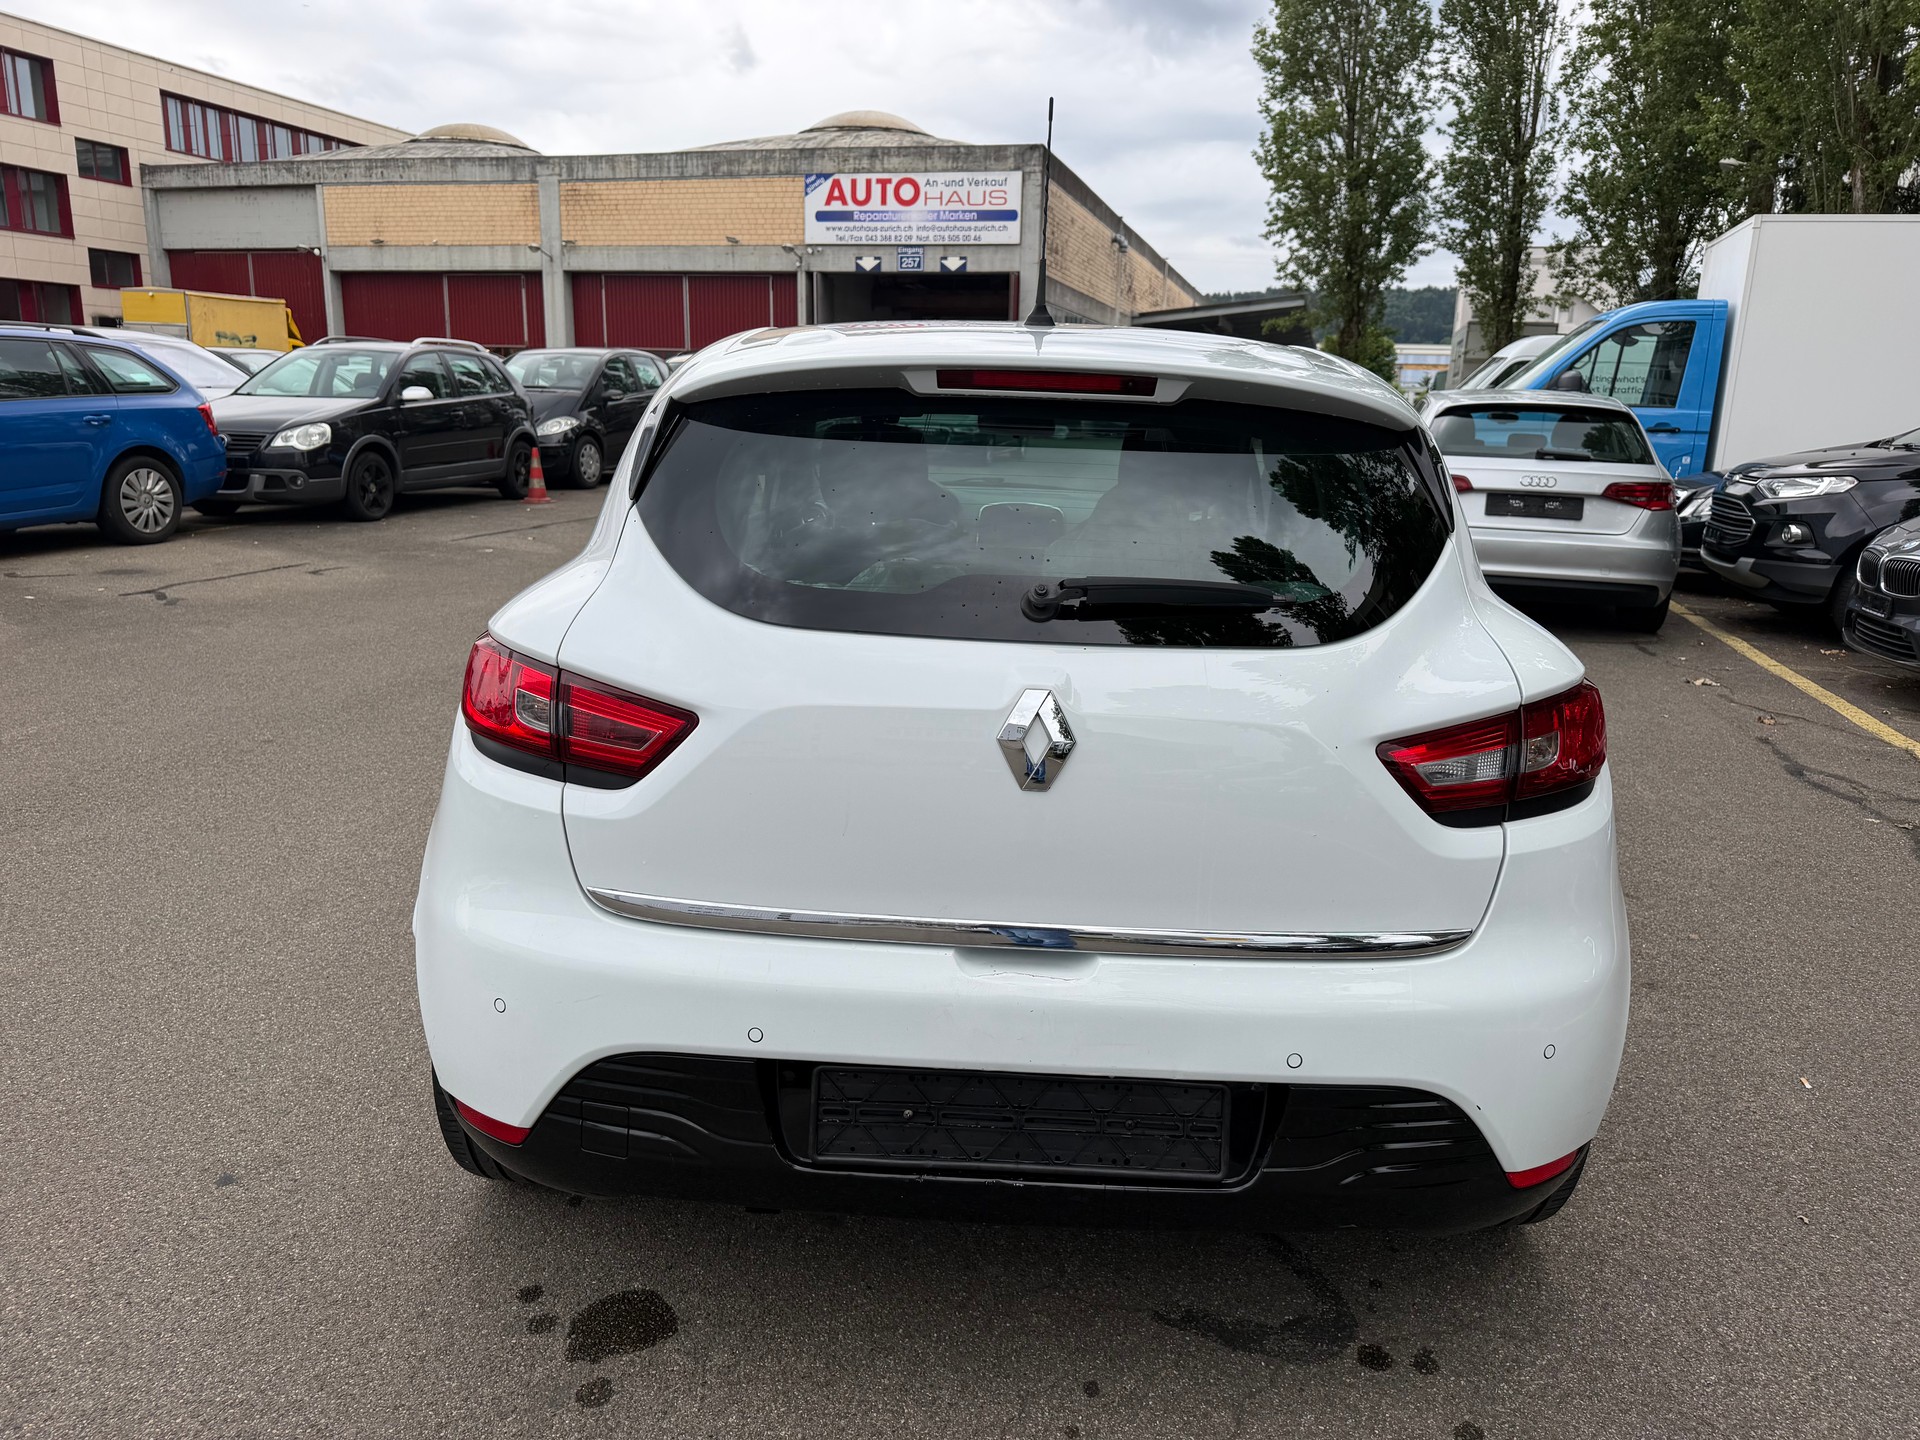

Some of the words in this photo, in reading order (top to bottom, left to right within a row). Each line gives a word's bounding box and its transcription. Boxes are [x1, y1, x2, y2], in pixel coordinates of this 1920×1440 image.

[924, 178, 938, 187] An
[967, 177, 1008, 187] Verkauf
[824, 177, 920, 206] AUTO
[924, 189, 1008, 206] HAUS
[939, 211, 978, 221] Marken
[898, 246, 924, 254] Eingang
[901, 257, 920, 268] 257
